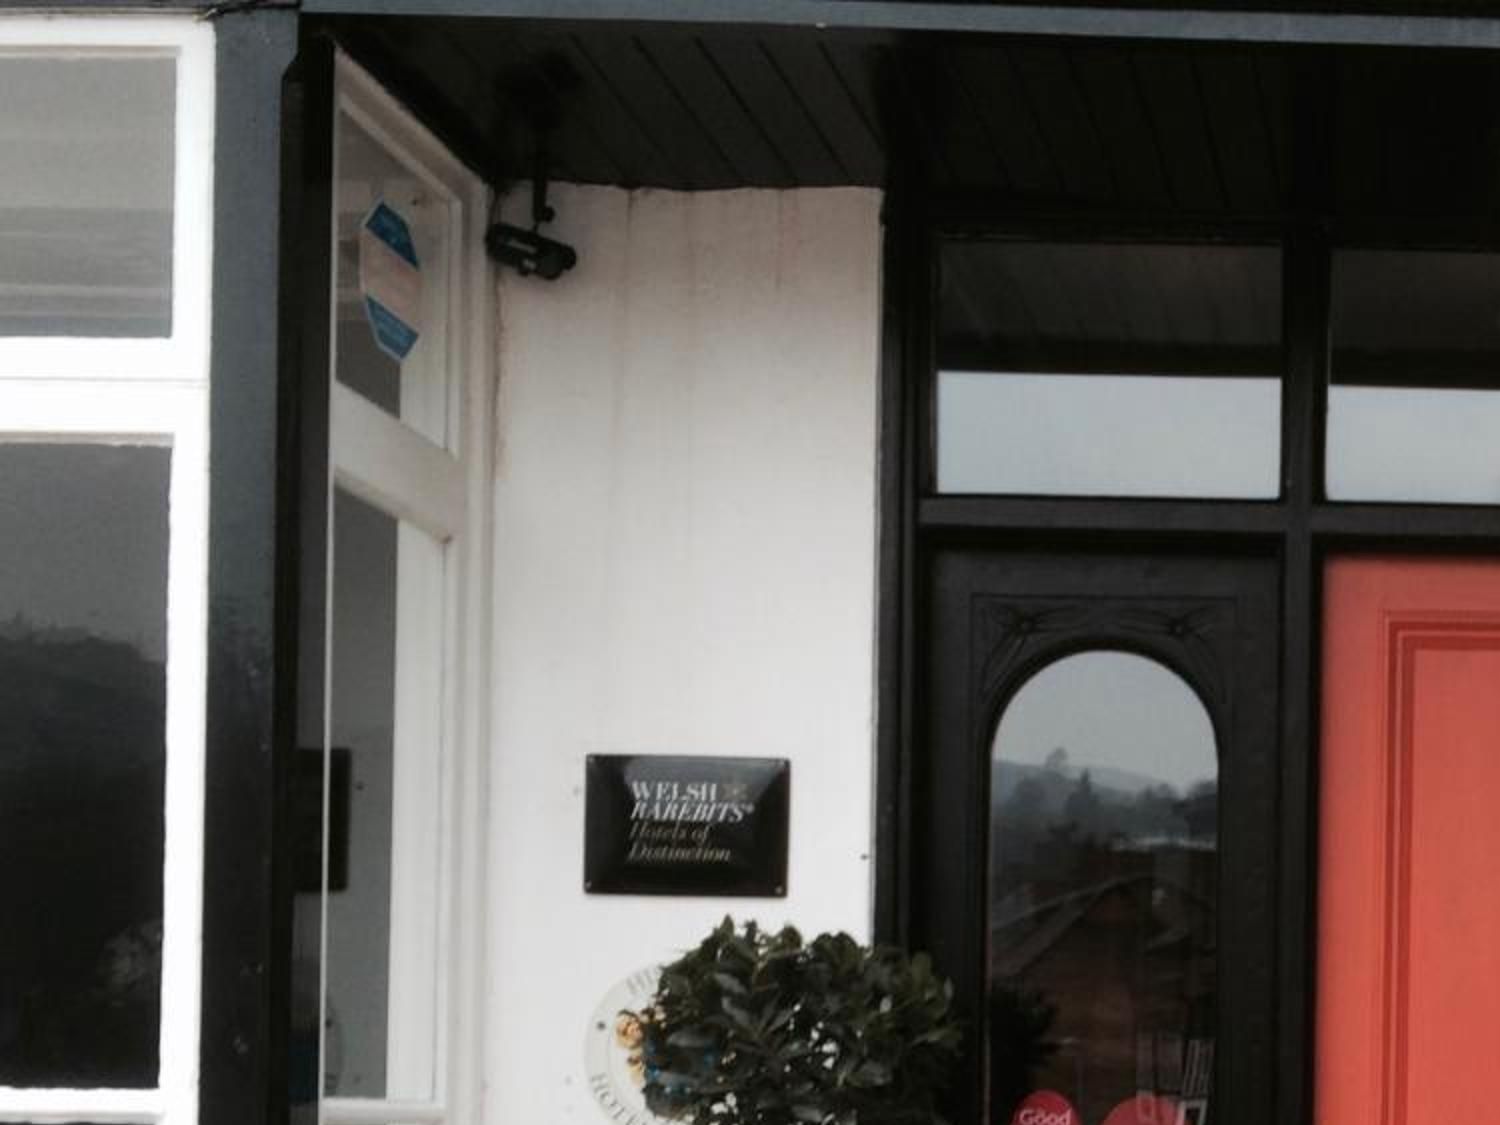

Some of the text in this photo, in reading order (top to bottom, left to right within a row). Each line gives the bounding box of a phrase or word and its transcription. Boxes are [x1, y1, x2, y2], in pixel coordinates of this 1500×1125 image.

[631, 781, 718, 801] WELSH
[691, 824, 711, 845] of
[626, 842, 732, 862] Distinction
[1019, 1106, 1072, 1125] Good
